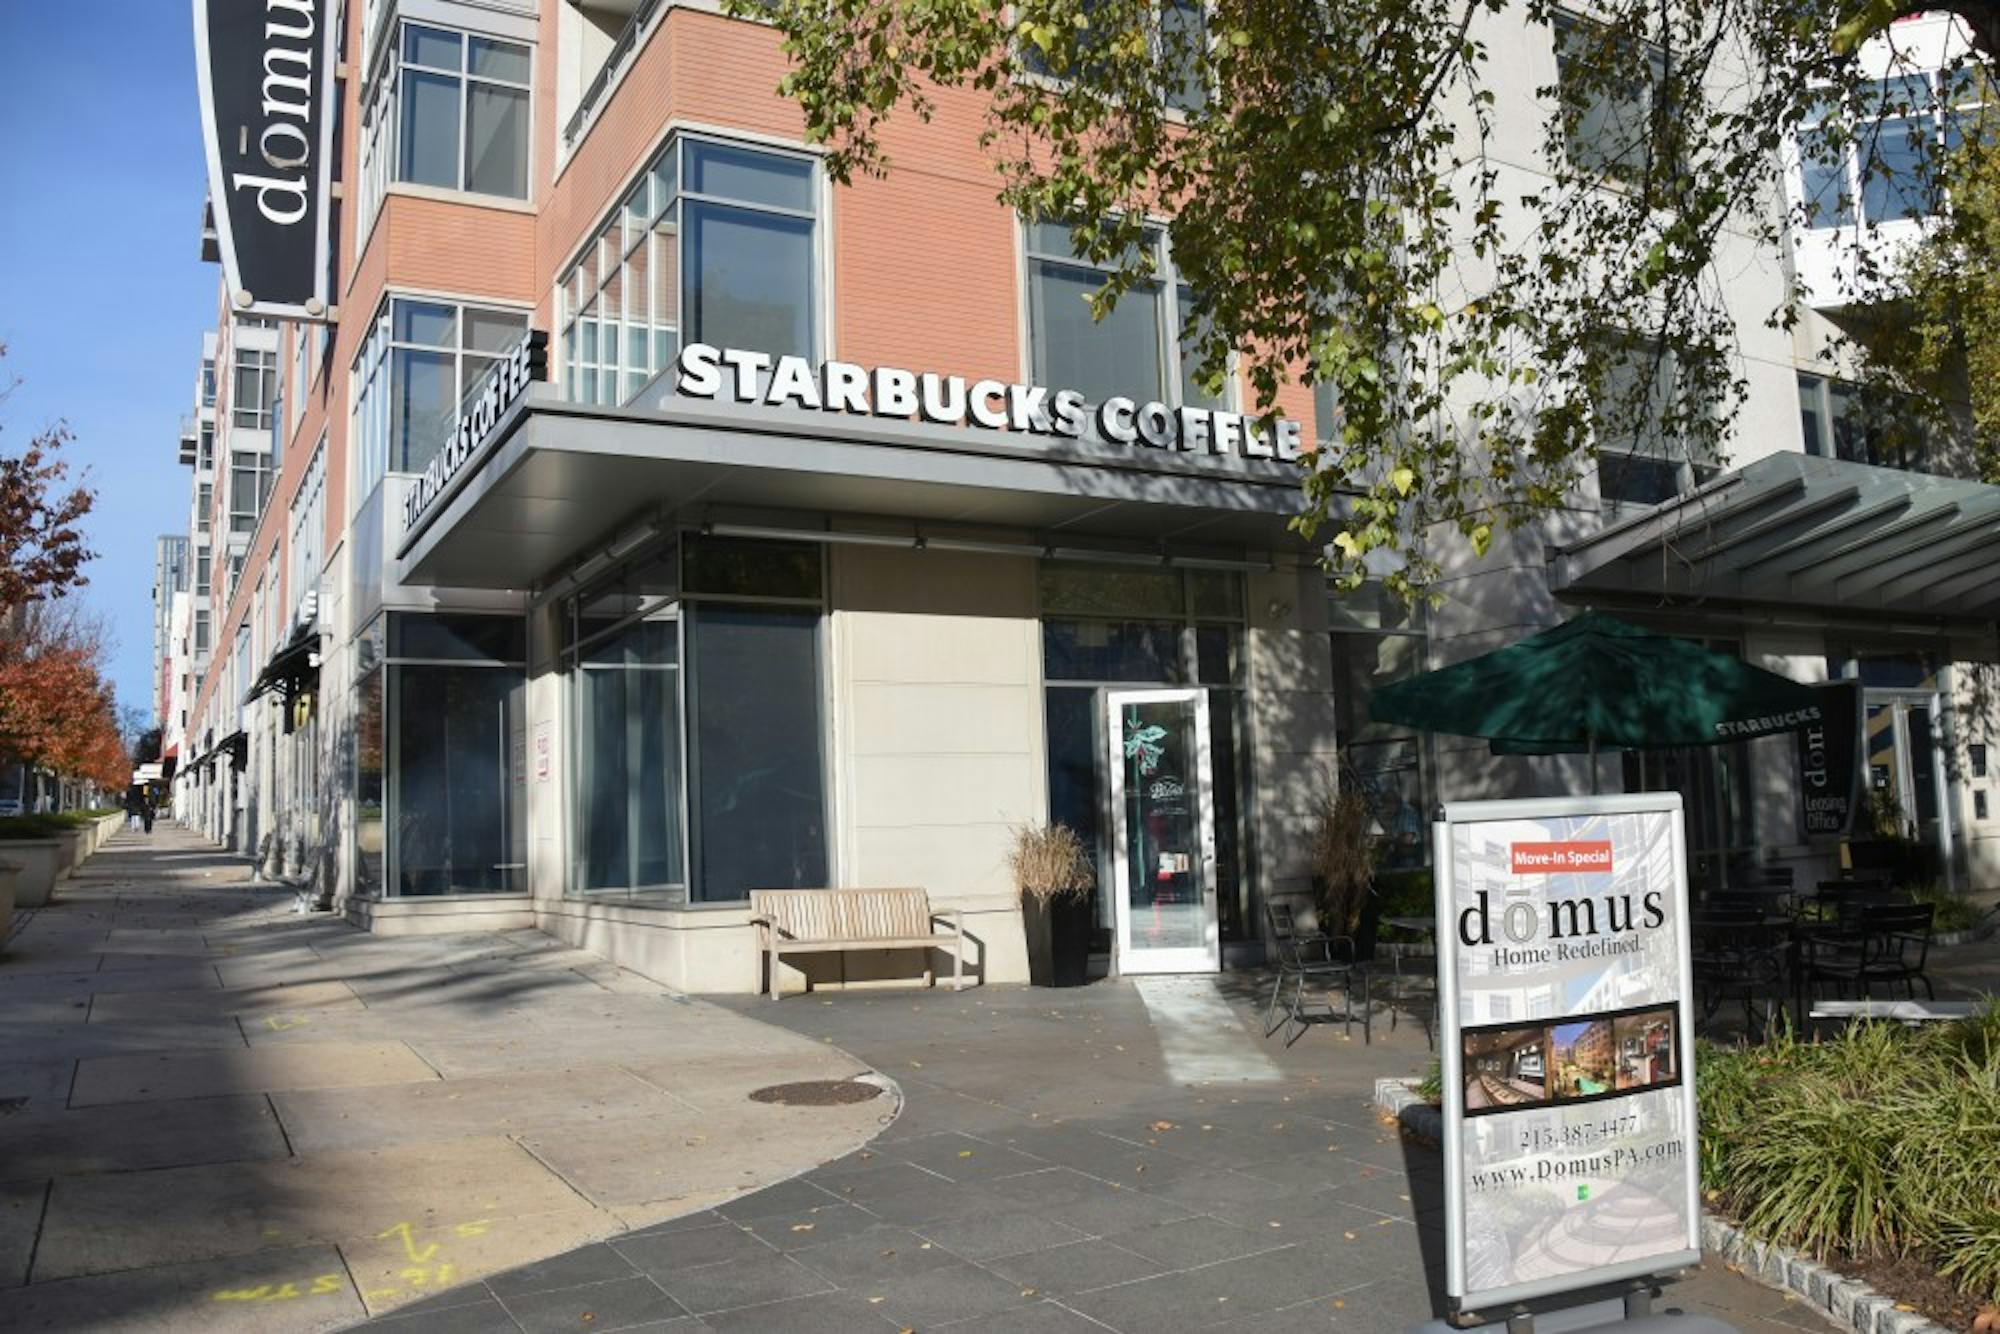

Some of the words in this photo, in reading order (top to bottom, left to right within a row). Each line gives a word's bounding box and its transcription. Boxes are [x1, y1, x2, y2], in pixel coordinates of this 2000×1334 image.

[232, 0, 316, 225] dōmu
[677, 343, 1088, 437] STARBUCKS
[1097, 396, 1302, 462] COFFEE
[404, 413, 471, 532] STARBUCKS
[470, 330, 538, 448] COFFEE
[1715, 706, 1822, 736] STARBUCKS
[1805, 794, 1848, 814] Leasing
[1807, 811, 1840, 830] Office
[1514, 850, 1565, 866] Move-In
[1568, 849, 1610, 867] Special
[1494, 948, 1551, 967] Home
[1557, 934, 1645, 961] Redefined.
[1471, 1138, 1684, 1189] www.DomusPA.com
